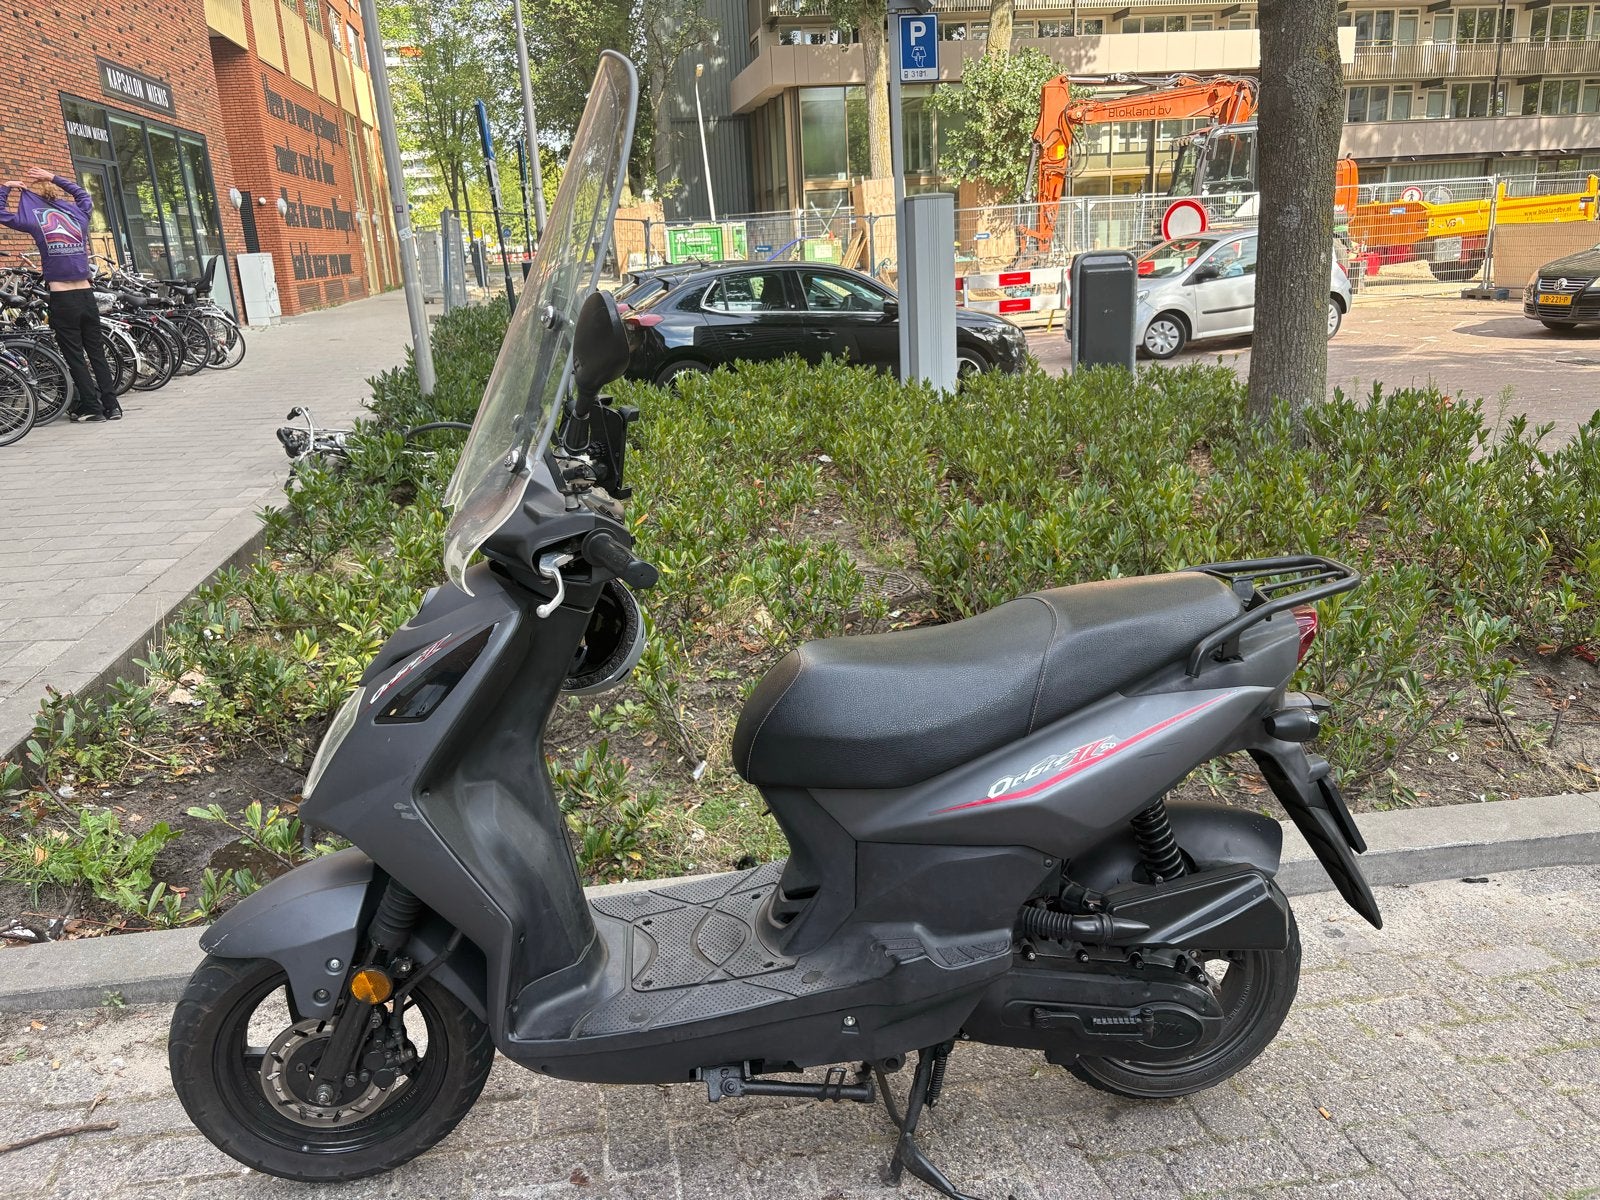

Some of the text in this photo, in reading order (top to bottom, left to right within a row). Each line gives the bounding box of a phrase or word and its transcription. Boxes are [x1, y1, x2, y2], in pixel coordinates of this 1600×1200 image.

[910, 21, 926, 46] P
[106, 67, 144, 99] KAPSALON
[1108, 106, 1172, 118] Blokland bv
[66, 120, 93, 139] KAPSALON
